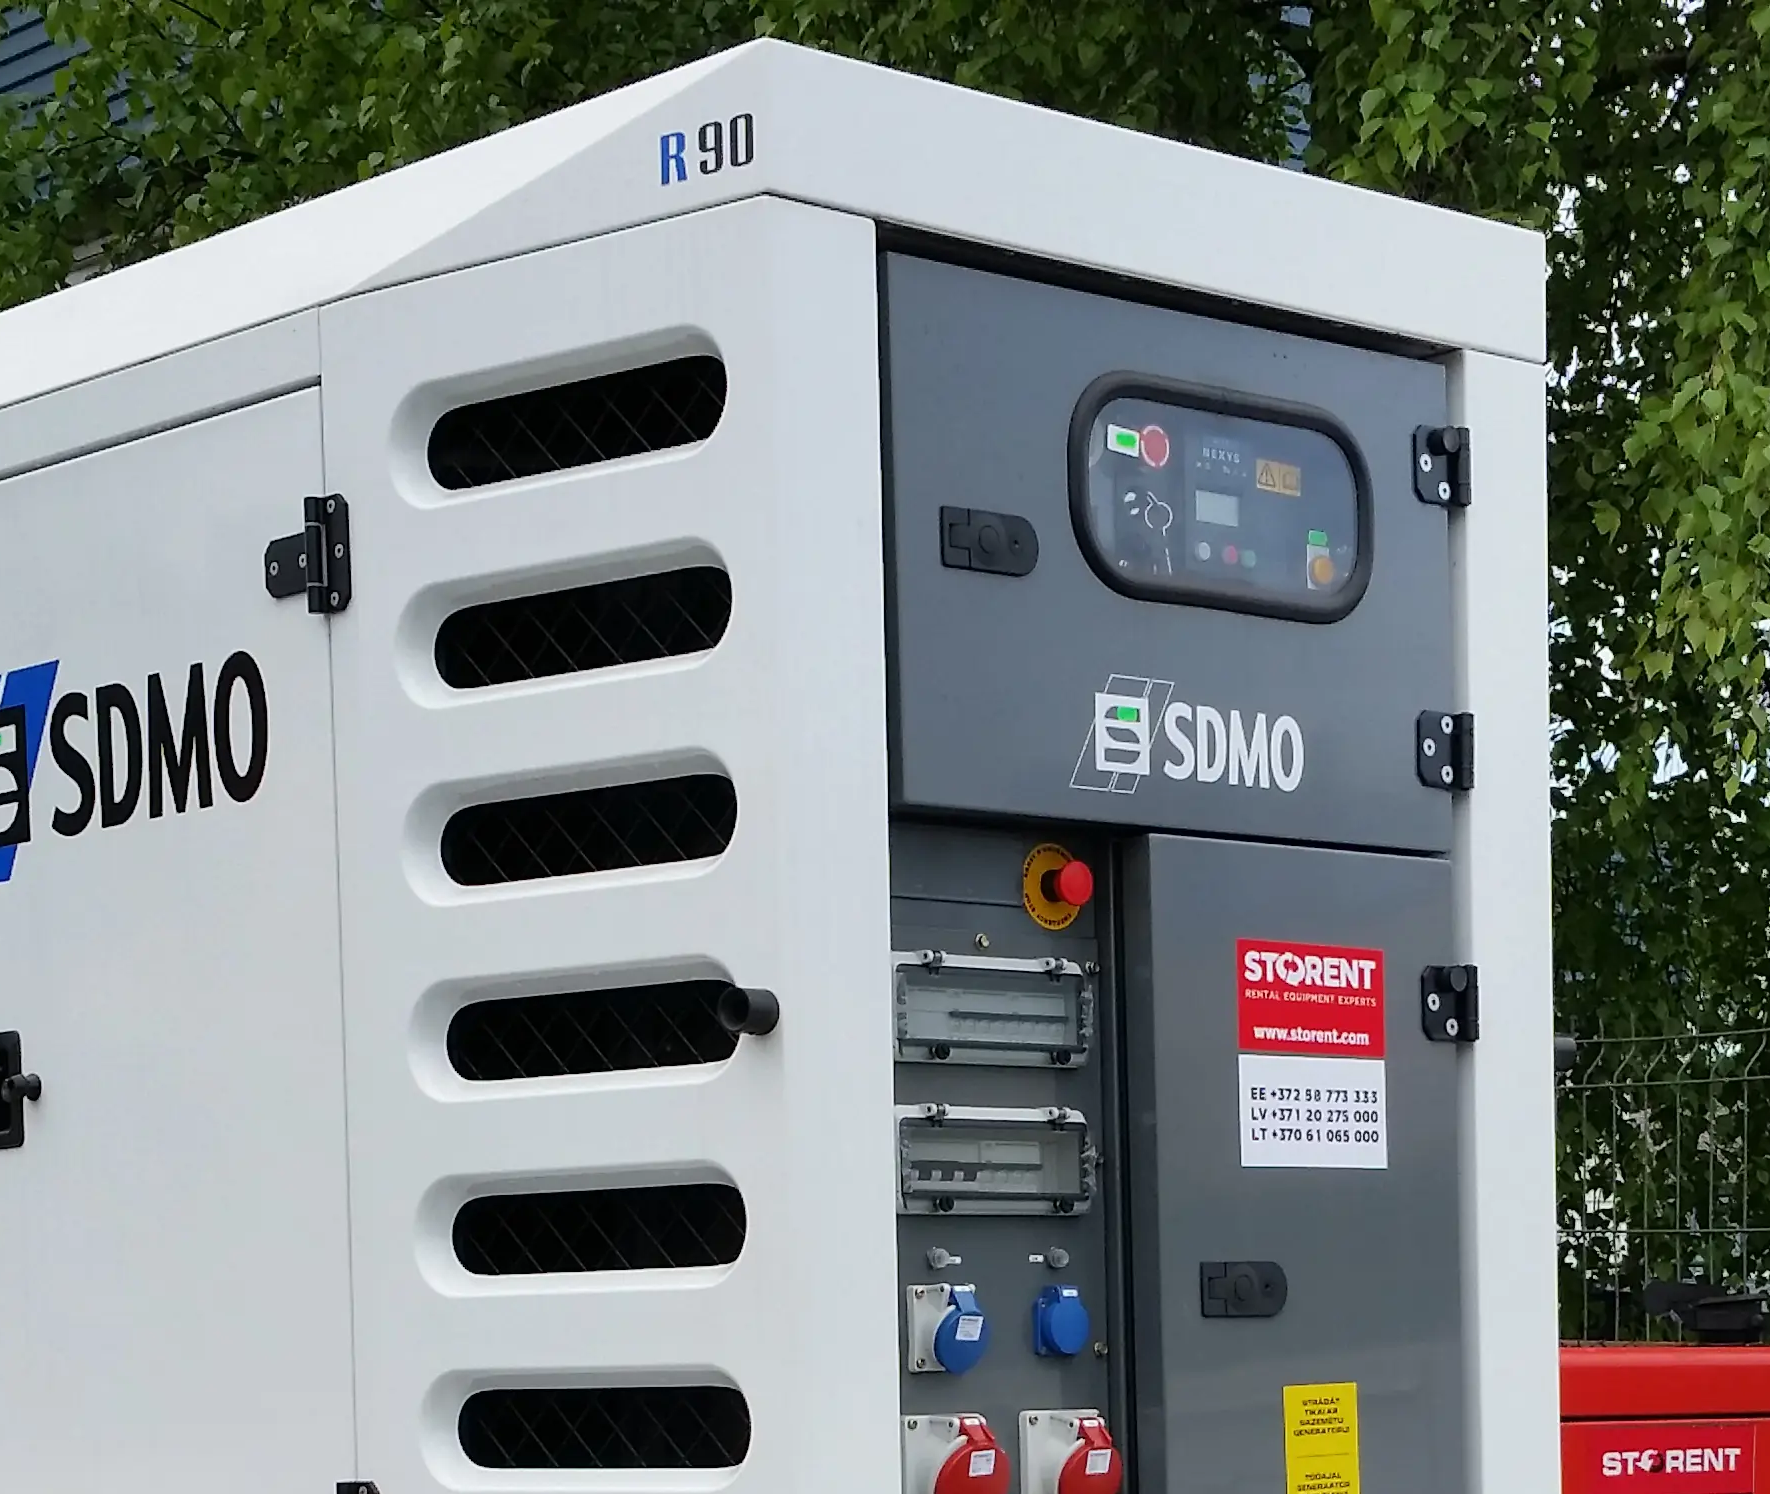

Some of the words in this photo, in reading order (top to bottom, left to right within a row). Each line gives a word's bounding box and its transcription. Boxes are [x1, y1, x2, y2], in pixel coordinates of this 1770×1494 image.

[659, 131, 688, 186] R
[697, 112, 755, 175] 90
[49, 650, 269, 837] SDMO
[1162, 701, 1305, 793] SDMO
[1243, 950, 1377, 989] STORENT
[1244, 988, 1281, 1001] RENTAL
[1283, 991, 1335, 1005] EQUIPMENT
[1337, 995, 1377, 1008] EXPERTS
[1253, 1025, 1370, 1046] www.storent.com
[1250, 1087, 1267, 1101] EE
[1270, 1087, 1301, 1102] +372
[1326, 1089, 1349, 1103] 773
[1353, 1090, 1378, 1104] 333
[1251, 1107, 1268, 1121] LV
[1271, 1108, 1301, 1121] +371
[1306, 1109, 1322, 1122] 20
[1326, 1109, 1349, 1123] 275
[1353, 1110, 1379, 1123] 000
[1251, 1127, 1268, 1141] LT
[1271, 1128, 1302, 1141] +370
[1306, 1128, 1322, 1142] 61
[1326, 1129, 1350, 1143] 065
[1354, 1130, 1380, 1143] 000
[1601, 1447, 1742, 1477] STORENT
